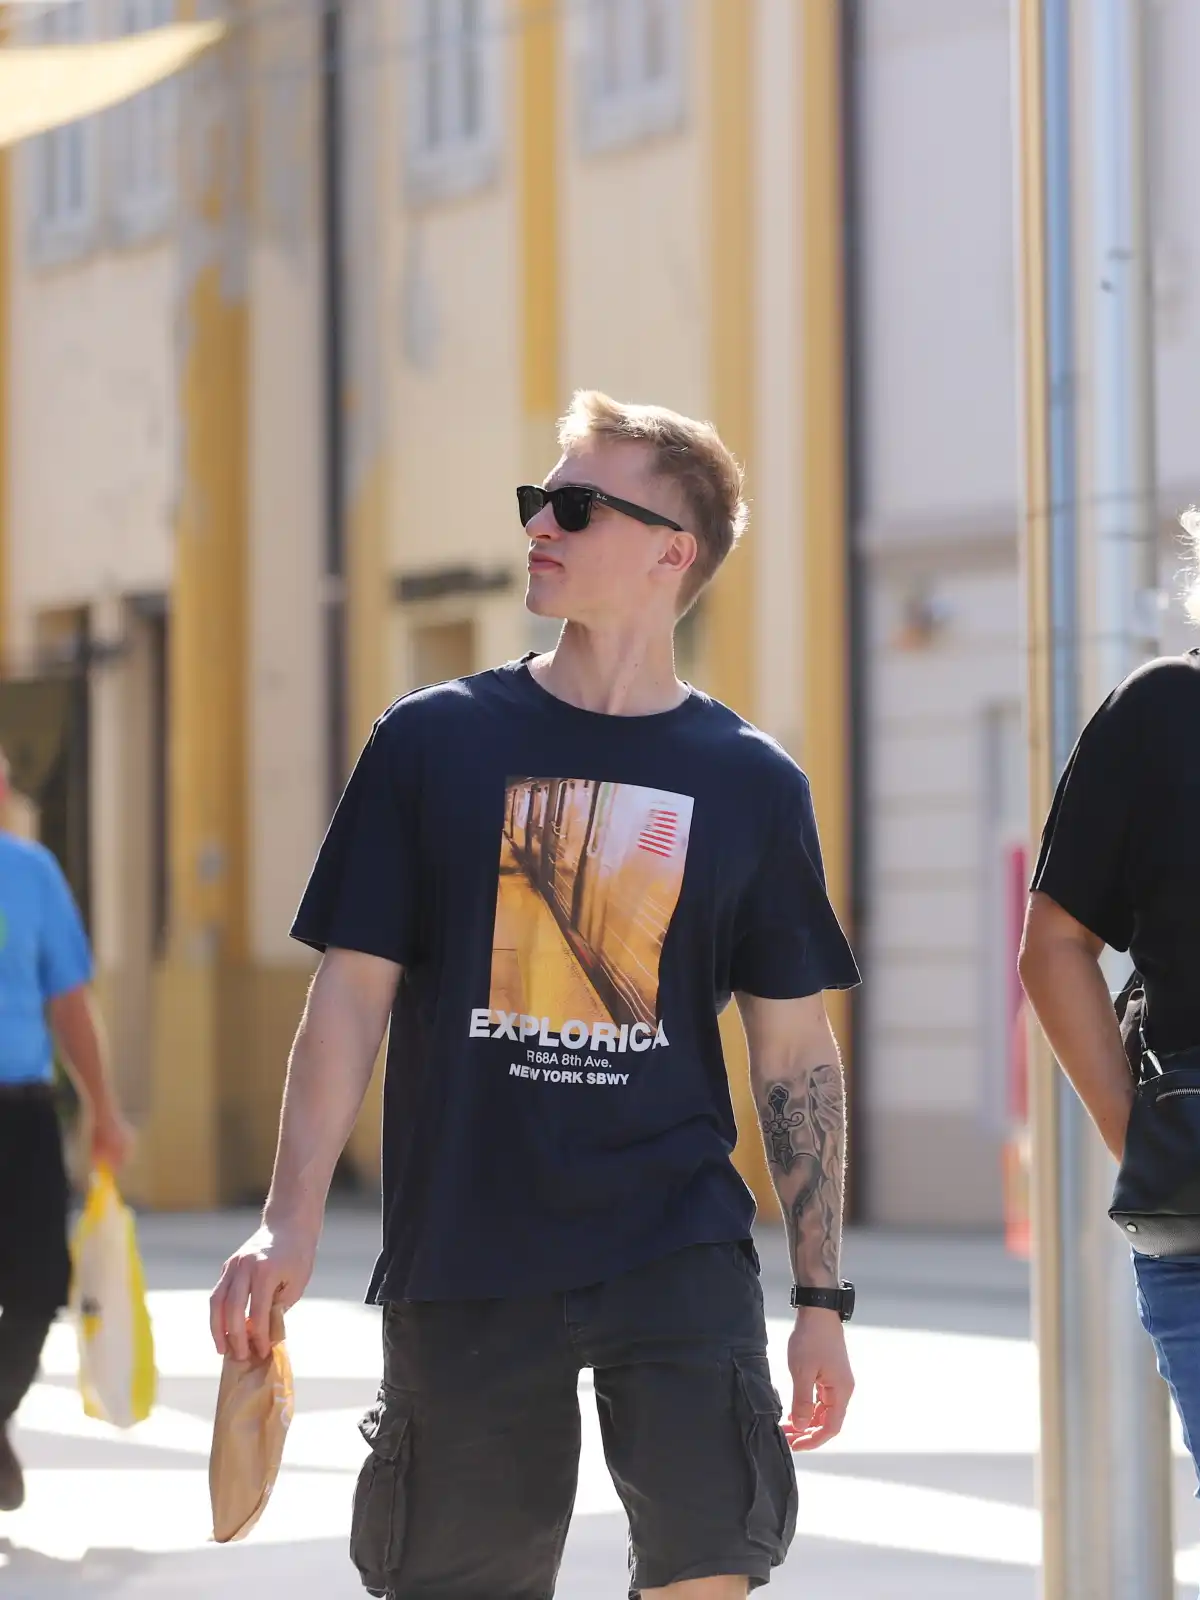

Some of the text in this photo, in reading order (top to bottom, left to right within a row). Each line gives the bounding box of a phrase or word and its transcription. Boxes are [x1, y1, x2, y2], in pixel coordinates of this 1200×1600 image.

[469, 1008, 669, 1053] EXPLORICA
[526, 1050, 612, 1068] R68A 8th Ave.
[508, 1063, 630, 1086] NEW YORK SBWY
